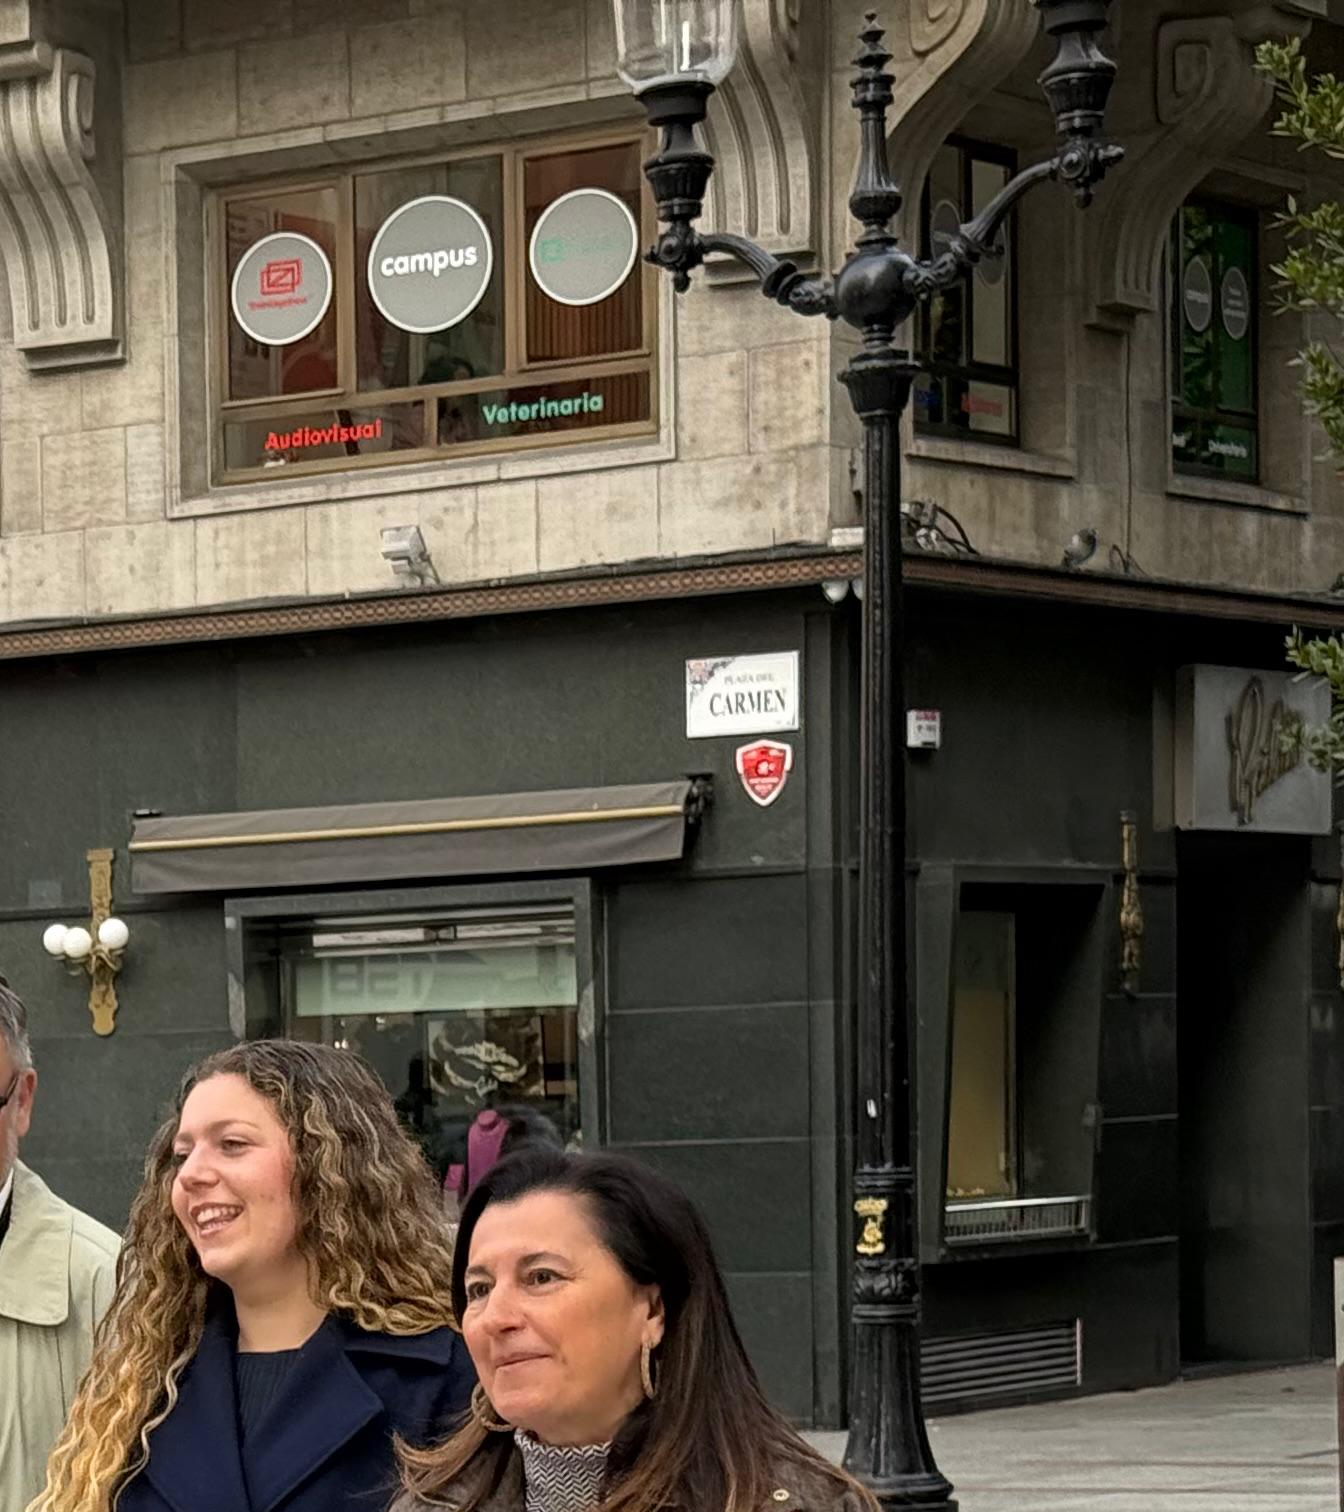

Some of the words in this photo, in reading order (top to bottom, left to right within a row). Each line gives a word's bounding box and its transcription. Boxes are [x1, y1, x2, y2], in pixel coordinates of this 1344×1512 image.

[381, 245, 478, 277] campus
[482, 391, 604, 426] Veterinaria
[264, 419, 382, 449] Audiovisual
[710, 689, 786, 718] CARMEN
